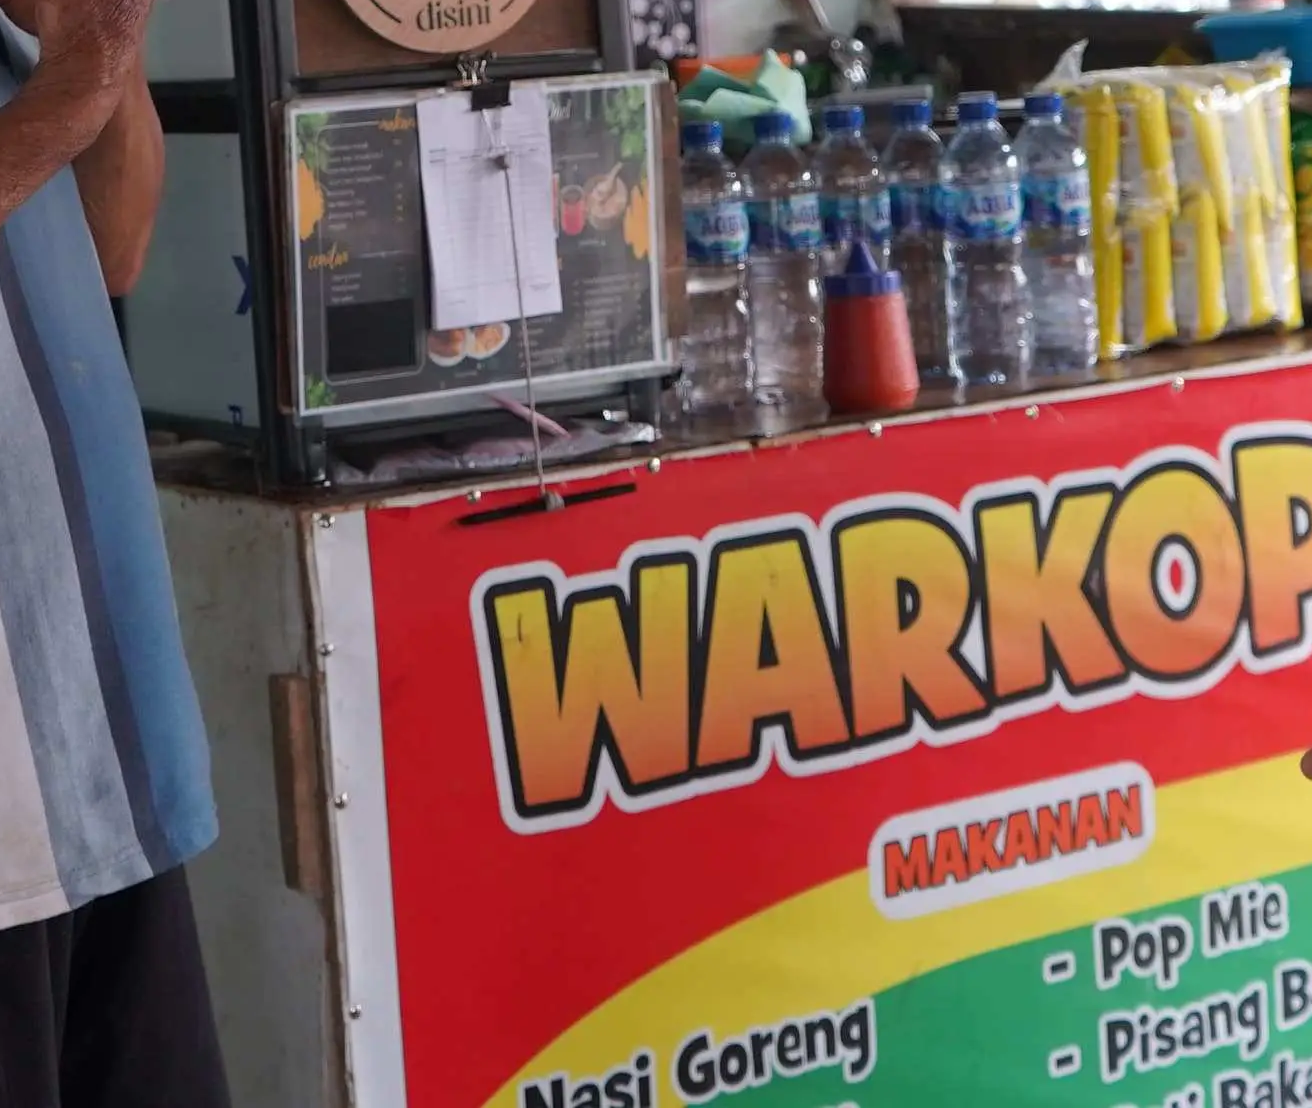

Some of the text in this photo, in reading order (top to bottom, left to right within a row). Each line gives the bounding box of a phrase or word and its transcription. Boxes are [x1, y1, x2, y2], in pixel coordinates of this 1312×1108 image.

[883, 783, 1144, 898] MAKANAN
[1100, 923, 1186, 983] Pop
[1207, 889, 1283, 950] Mie
[676, 1005, 871, 1096] Goreng
[1105, 989, 1262, 1075] Pisang
